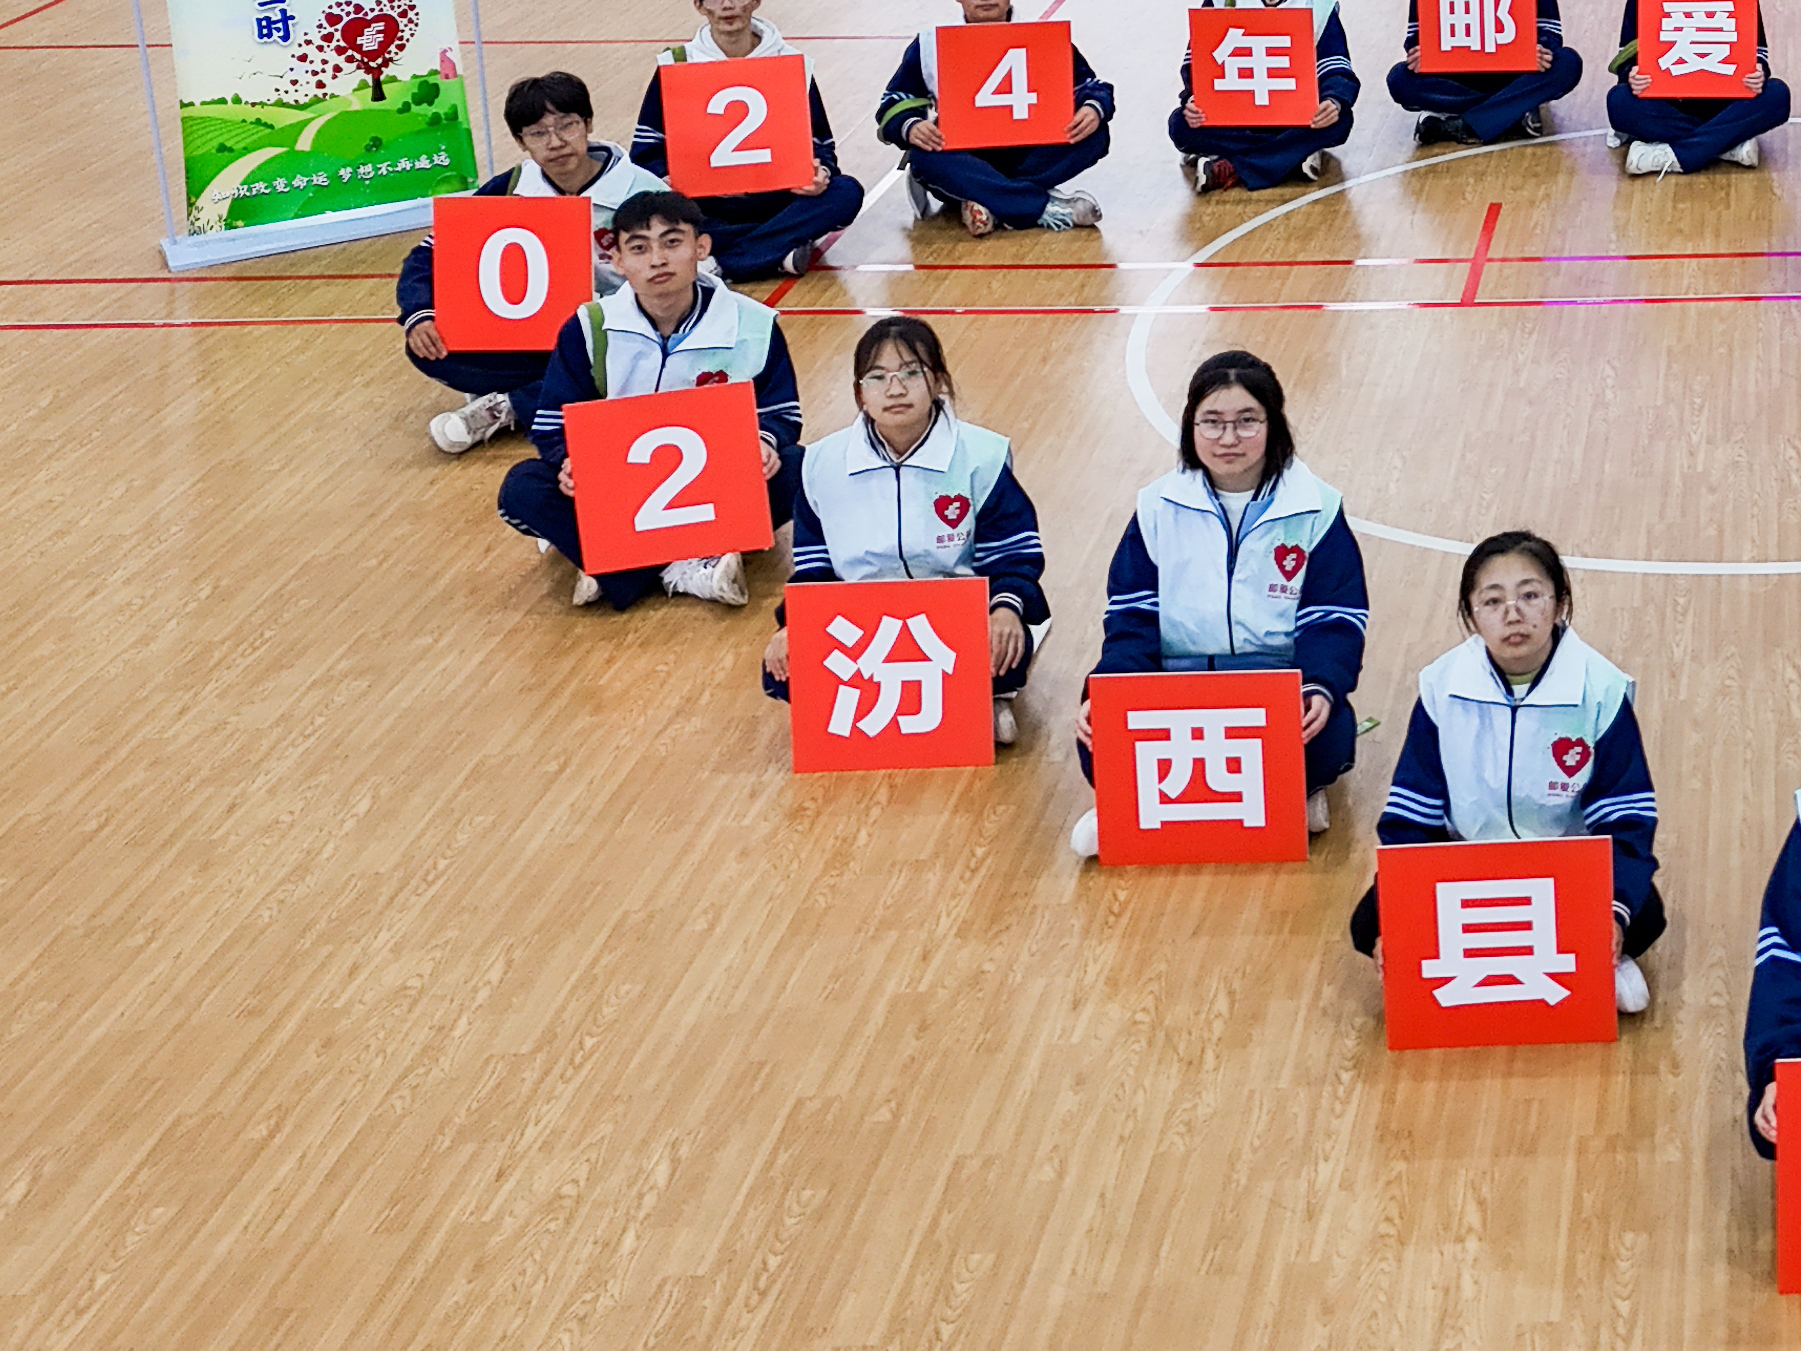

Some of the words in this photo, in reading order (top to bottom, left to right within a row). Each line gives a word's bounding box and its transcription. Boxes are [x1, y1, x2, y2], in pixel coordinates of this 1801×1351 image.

[1213, 30, 1296, 105] 年
[1659, 3, 1737, 76] 爱
[976, 48, 1037, 118] 4
[708, 88, 772, 167] 2
[210, 170, 331, 204] 知识改变命运
[480, 228, 549, 318] 0
[627, 427, 716, 531] 2
[826, 615, 956, 737] 汾
[1129, 710, 1266, 829] 西
[1424, 880, 1576, 1007] 县
